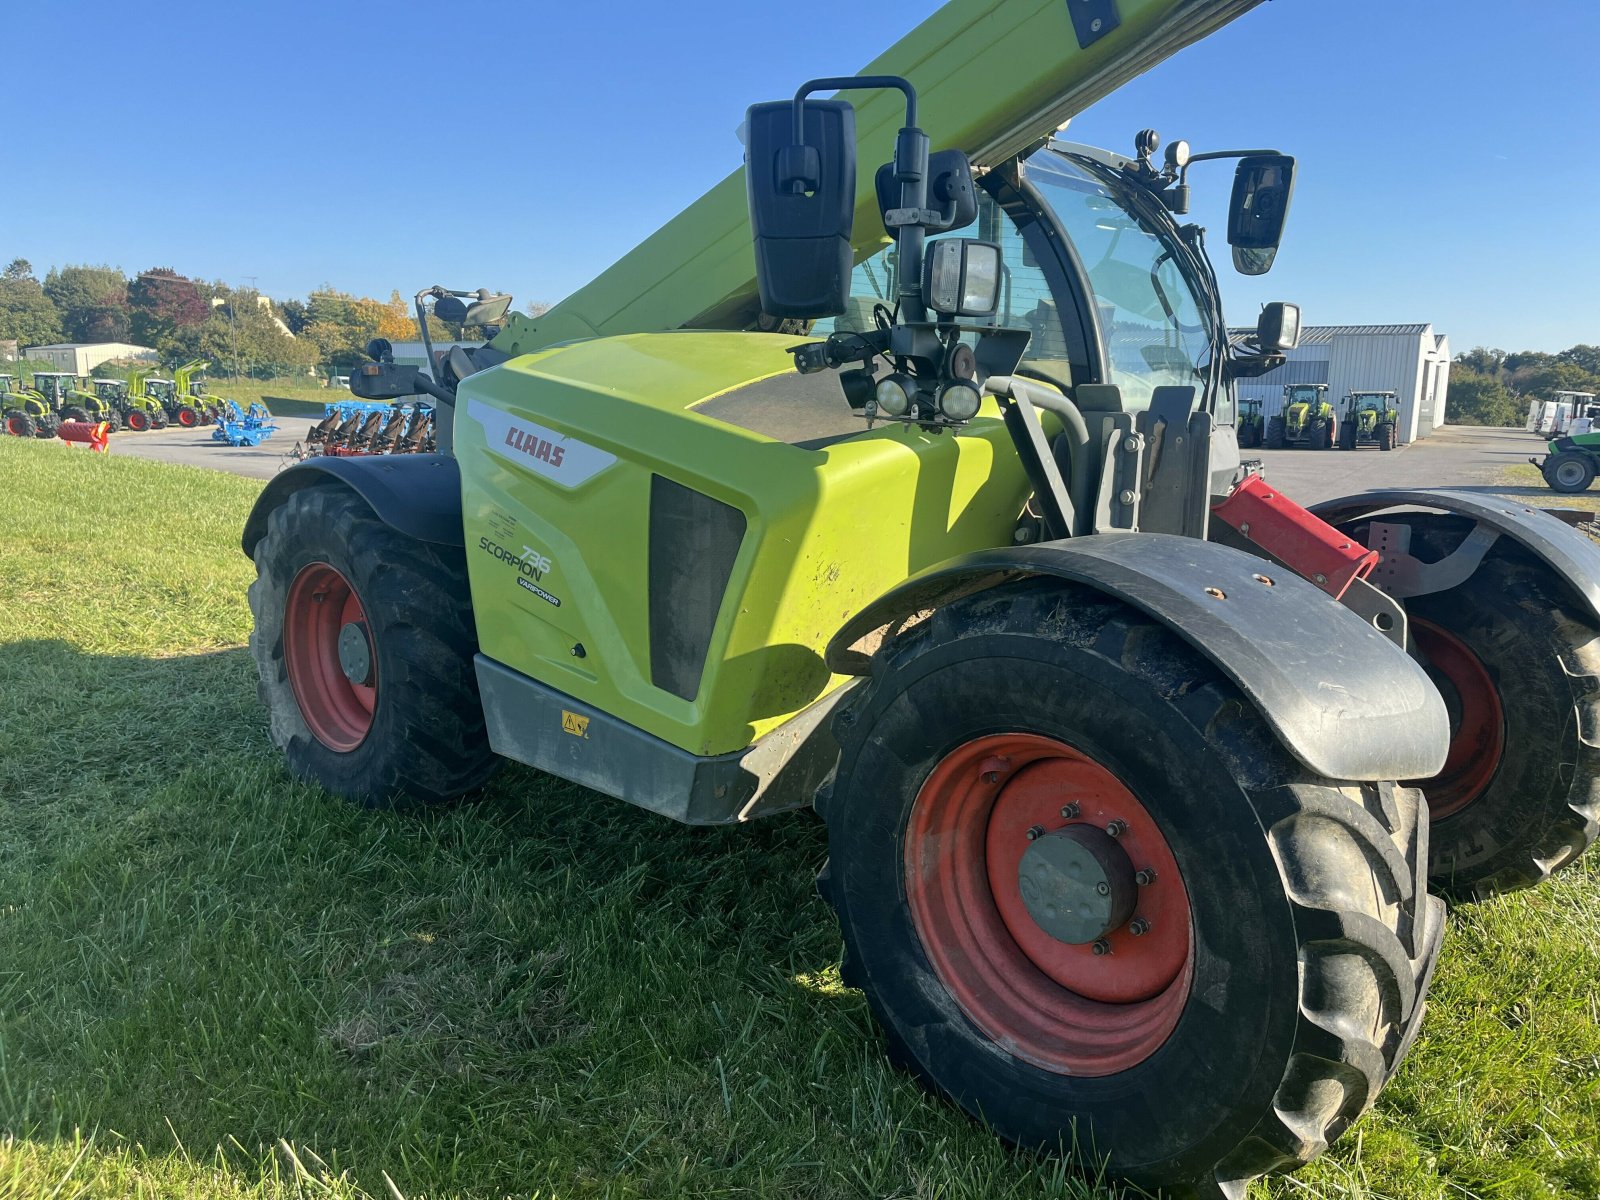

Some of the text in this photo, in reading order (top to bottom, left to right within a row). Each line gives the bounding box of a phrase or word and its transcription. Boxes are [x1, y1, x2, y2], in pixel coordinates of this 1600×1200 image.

[505, 427, 565, 467] CLAAS
[479, 537, 542, 582] SCORPION
[520, 545, 552, 573] 736
[519, 578, 559, 605] VARIPOWER
